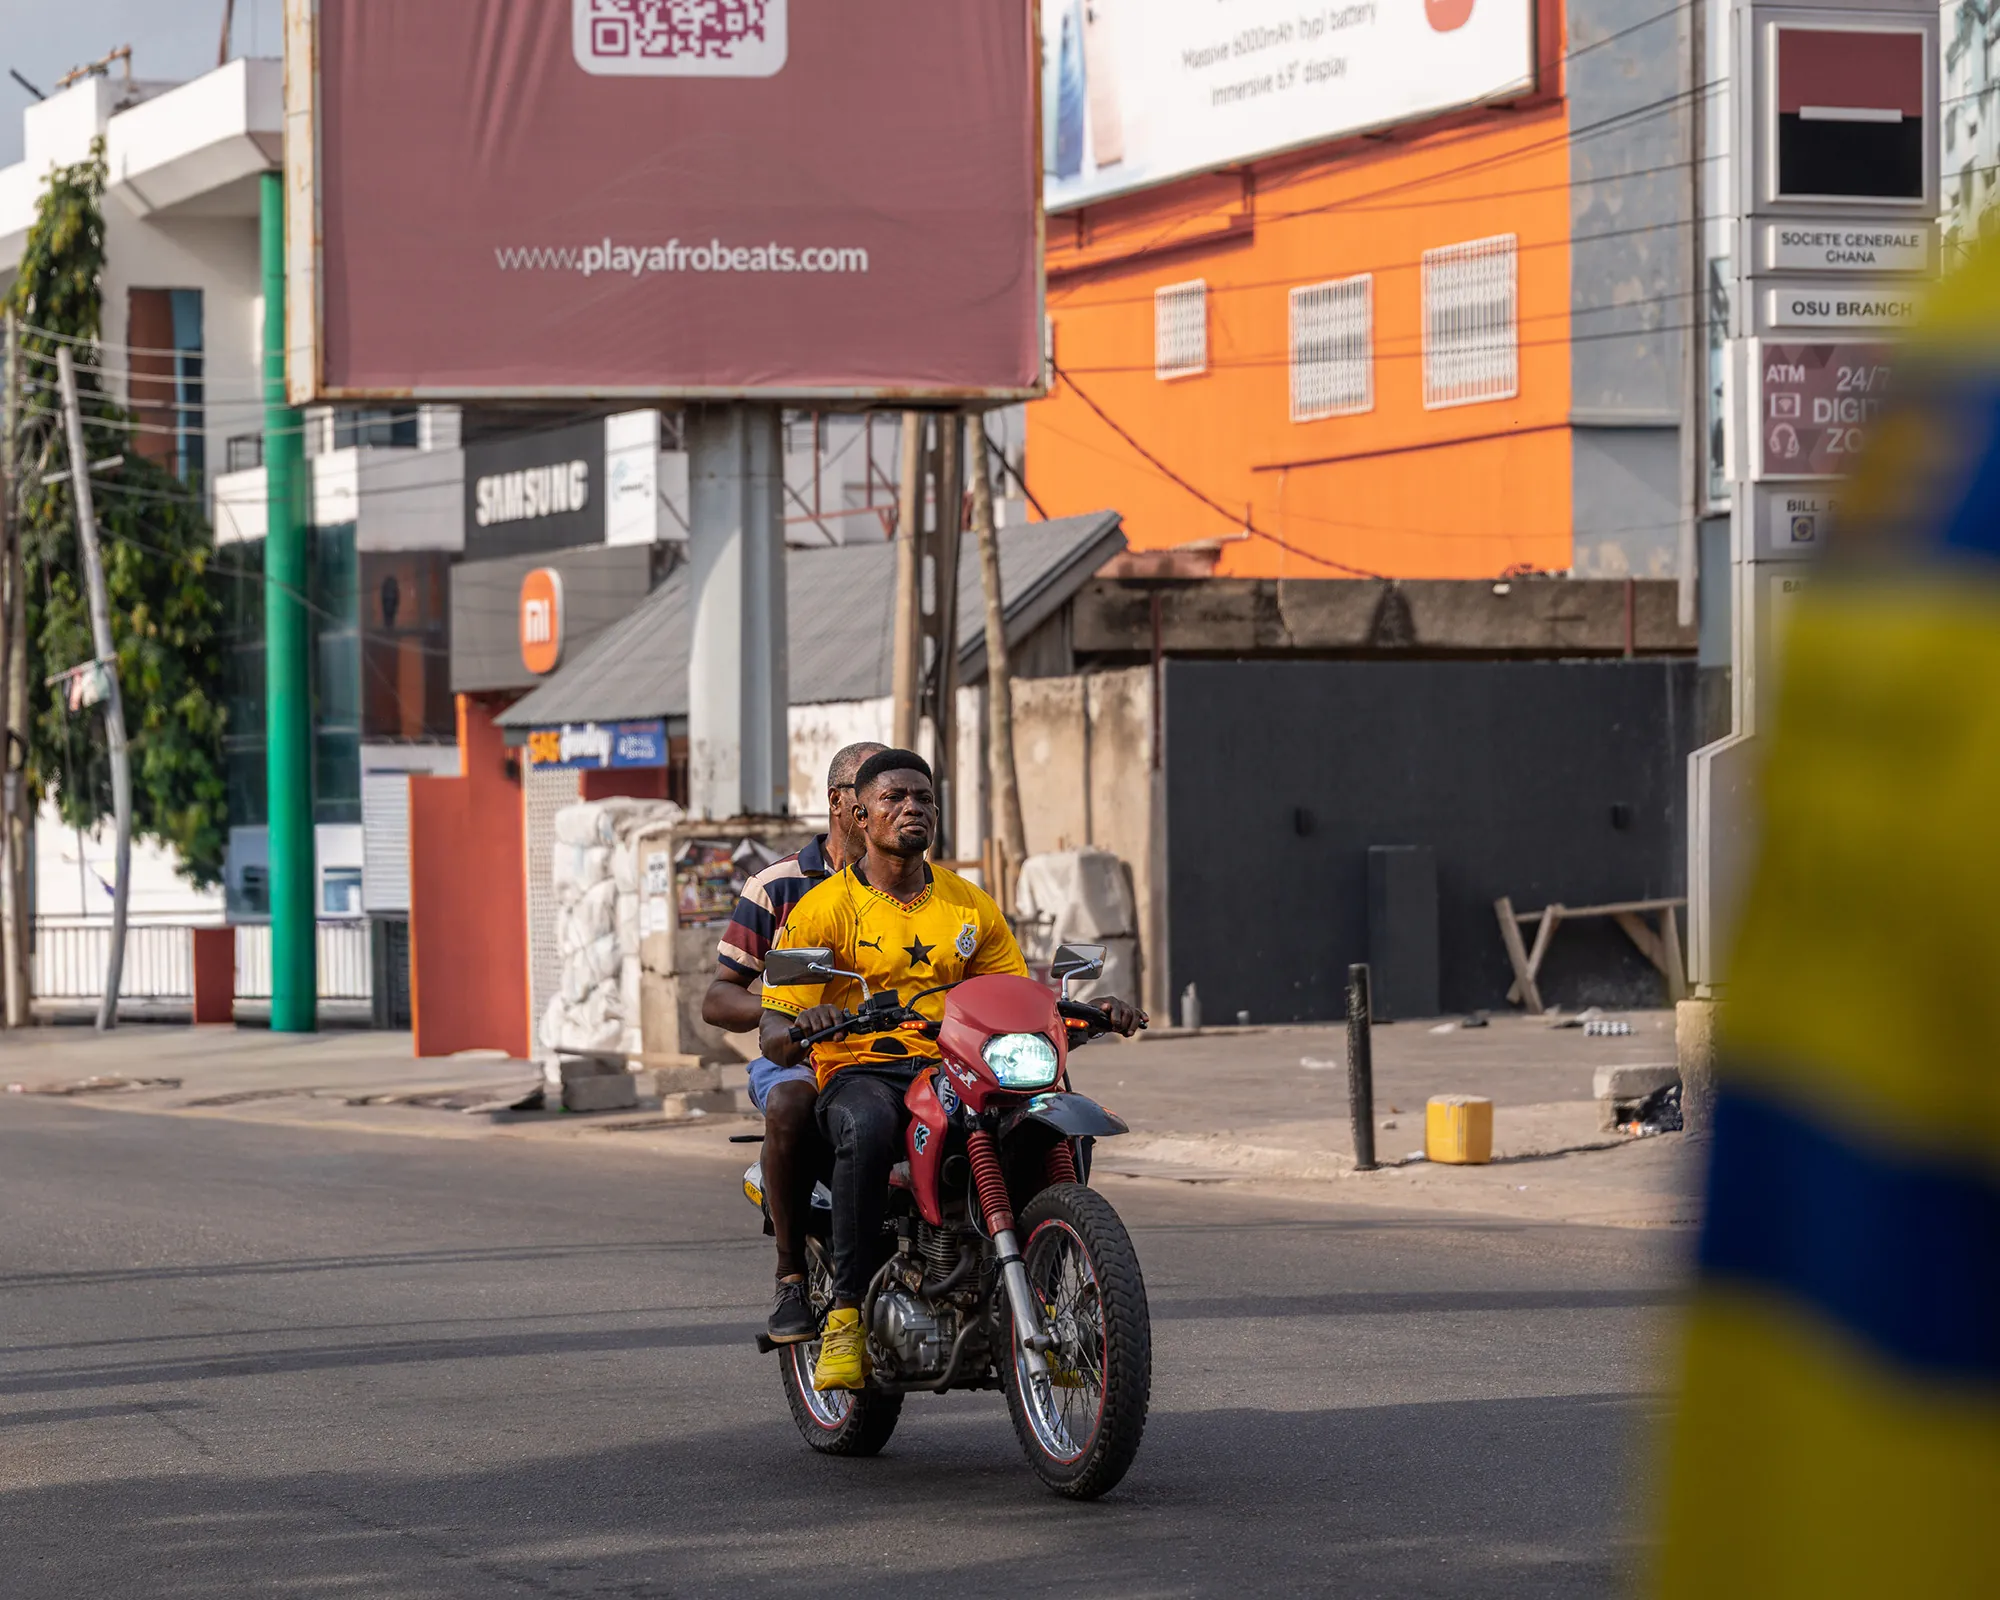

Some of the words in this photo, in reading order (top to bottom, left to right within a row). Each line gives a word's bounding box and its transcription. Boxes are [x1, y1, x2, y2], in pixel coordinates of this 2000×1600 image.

[1329, 1, 1377, 32] battery
[1303, 56, 1348, 85] display
[1781, 232, 1842, 247] SOCIETE
[1845, 233, 1920, 249] GENERALE
[495, 238, 869, 277] www.playafrobeats.com
[1825, 249, 1876, 264] GHANA
[1791, 301, 1830, 317] OSU
[1836, 301, 1913, 318] BRANCH
[1765, 364, 1806, 384] ATM
[1836, 365, 1892, 392] 24/7
[476, 459, 590, 528] SAMSUNG
[1786, 499, 1821, 513] BILL
